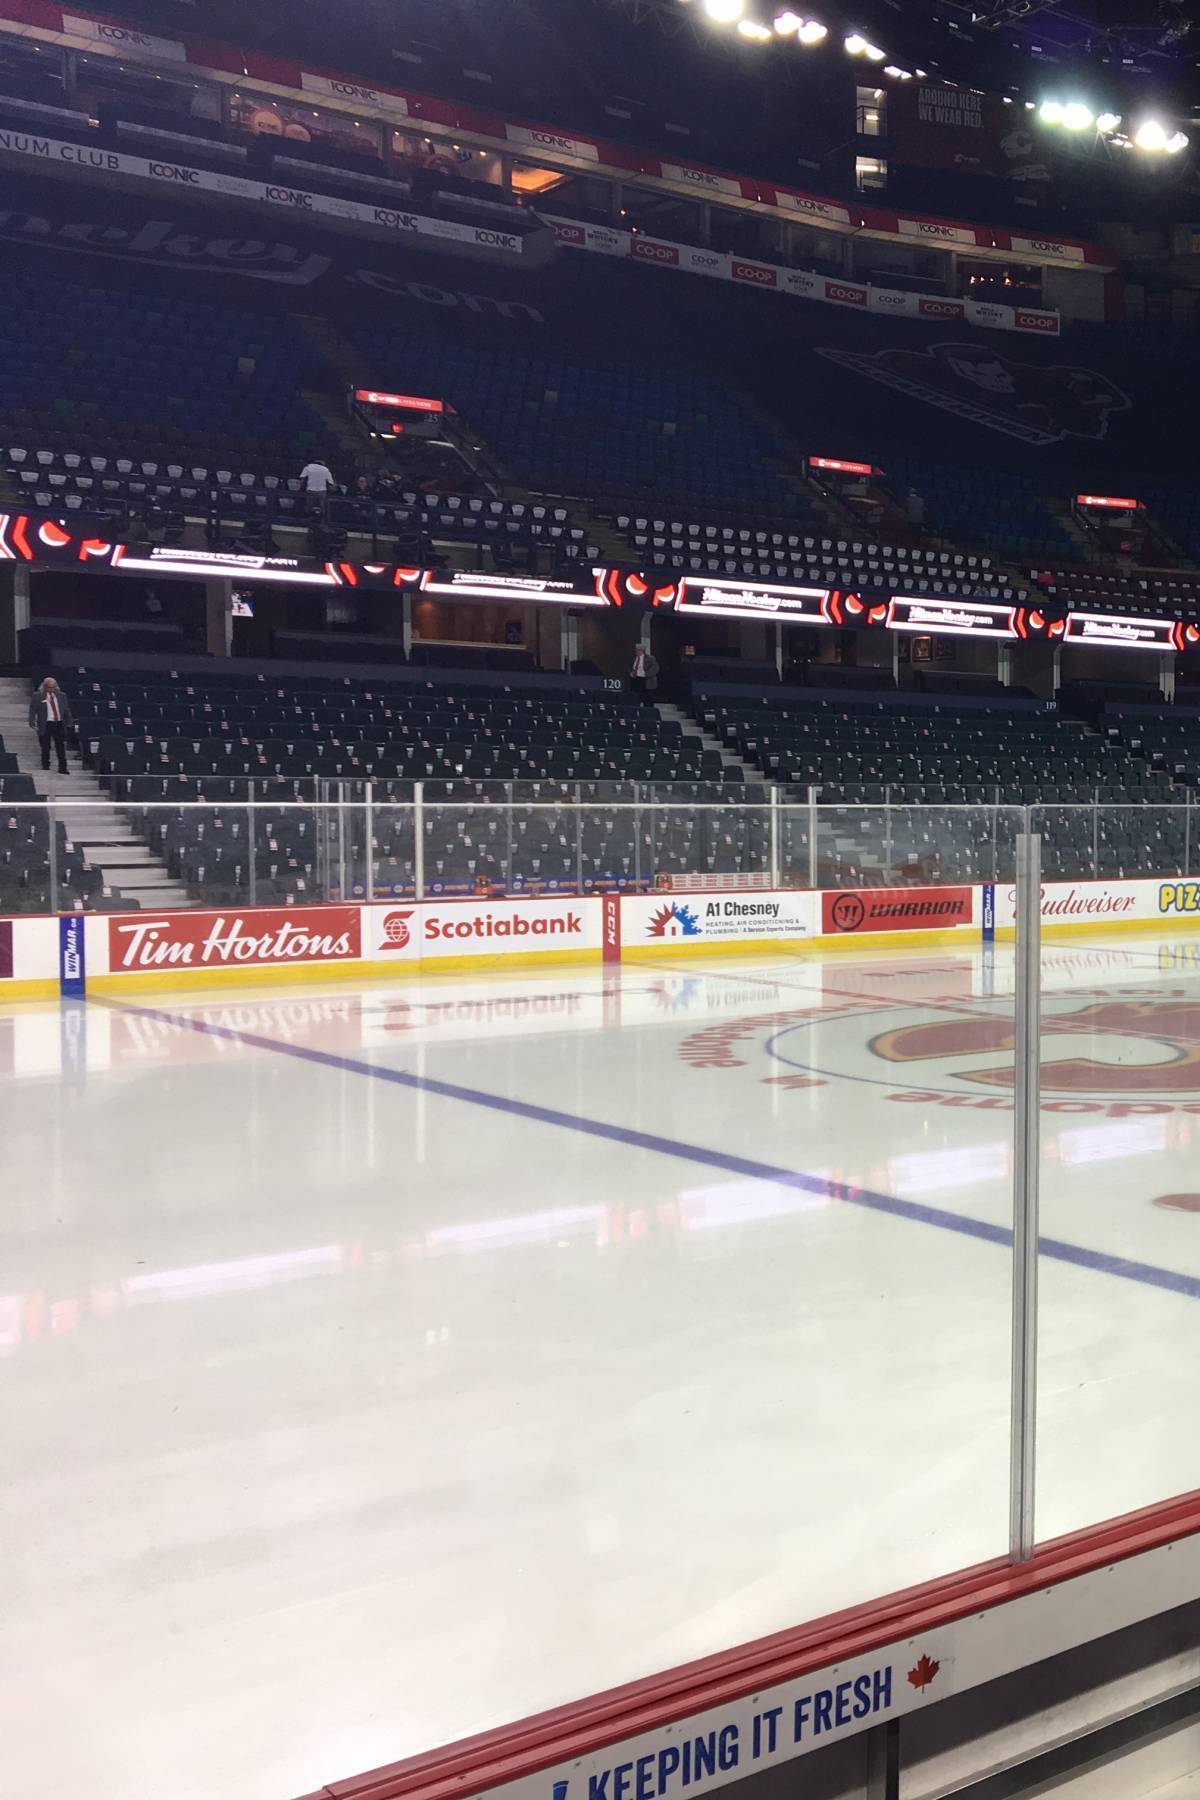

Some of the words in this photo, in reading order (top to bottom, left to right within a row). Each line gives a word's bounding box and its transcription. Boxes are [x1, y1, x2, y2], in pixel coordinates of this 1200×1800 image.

[98, 24, 152, 46] ICONIC
[331, 81, 376, 101] ICONIC
[918, 88, 958, 108] AROUND
[959, 93, 982, 112] HERE
[532, 132, 572, 150] ICONIC
[61, 146, 119, 170] CLUB
[150, 163, 199, 184] ICONIC
[683, 168, 719, 186] ICONIC
[266, 186, 312, 207] ICONIC
[795, 199, 829, 214] ICONIC
[375, 209, 418, 229] ICONIC
[475, 230, 516, 249] ICONIC
[919, 224, 954, 237] ICONIC
[636, 243, 673, 260] CO-OP
[1031, 242, 1064, 254] ICONIC
[737, 266, 772, 281] CO-OP
[830, 287, 863, 301] CO-OP
[924, 303, 960, 314] CO-OP
[1020, 316, 1054, 328] CO-OP
[603, 679, 621, 689] 120
[706, 903, 721, 917] A1
[724, 902, 780, 918] Chesney
[869, 900, 965, 918] WARRIOR
[424, 911, 582, 940] Scotiabank
[608, 901, 616, 944] CCM
[749, 919, 795, 927] CONDITIONING
[118, 922, 196, 967] Tim
[202, 917, 351, 960] Hortons
[589, 1722, 739, 1800] KEEPING
[752, 1706, 783, 1759] IT
[794, 1666, 893, 1743] FRESH
